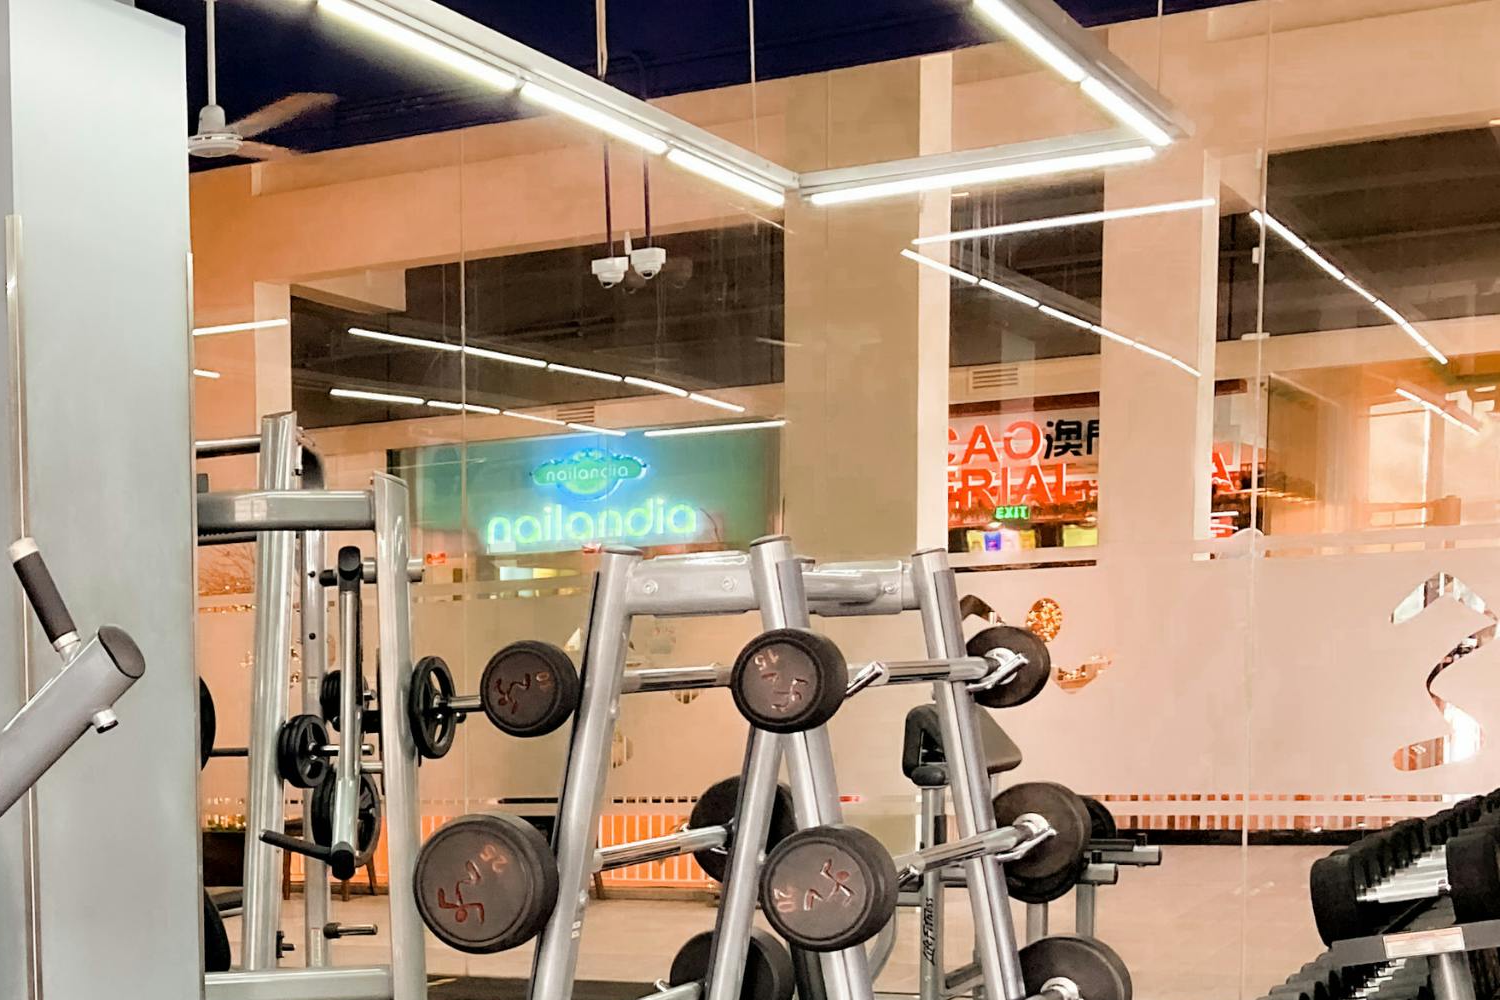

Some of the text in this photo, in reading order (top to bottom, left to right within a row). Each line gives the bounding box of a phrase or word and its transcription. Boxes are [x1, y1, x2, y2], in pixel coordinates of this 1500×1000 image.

[545, 465, 629, 482] nailandia
[487, 497, 697, 545] nailandia
[995, 506, 1028, 520] EXIT
[480, 844, 508, 874] 25
